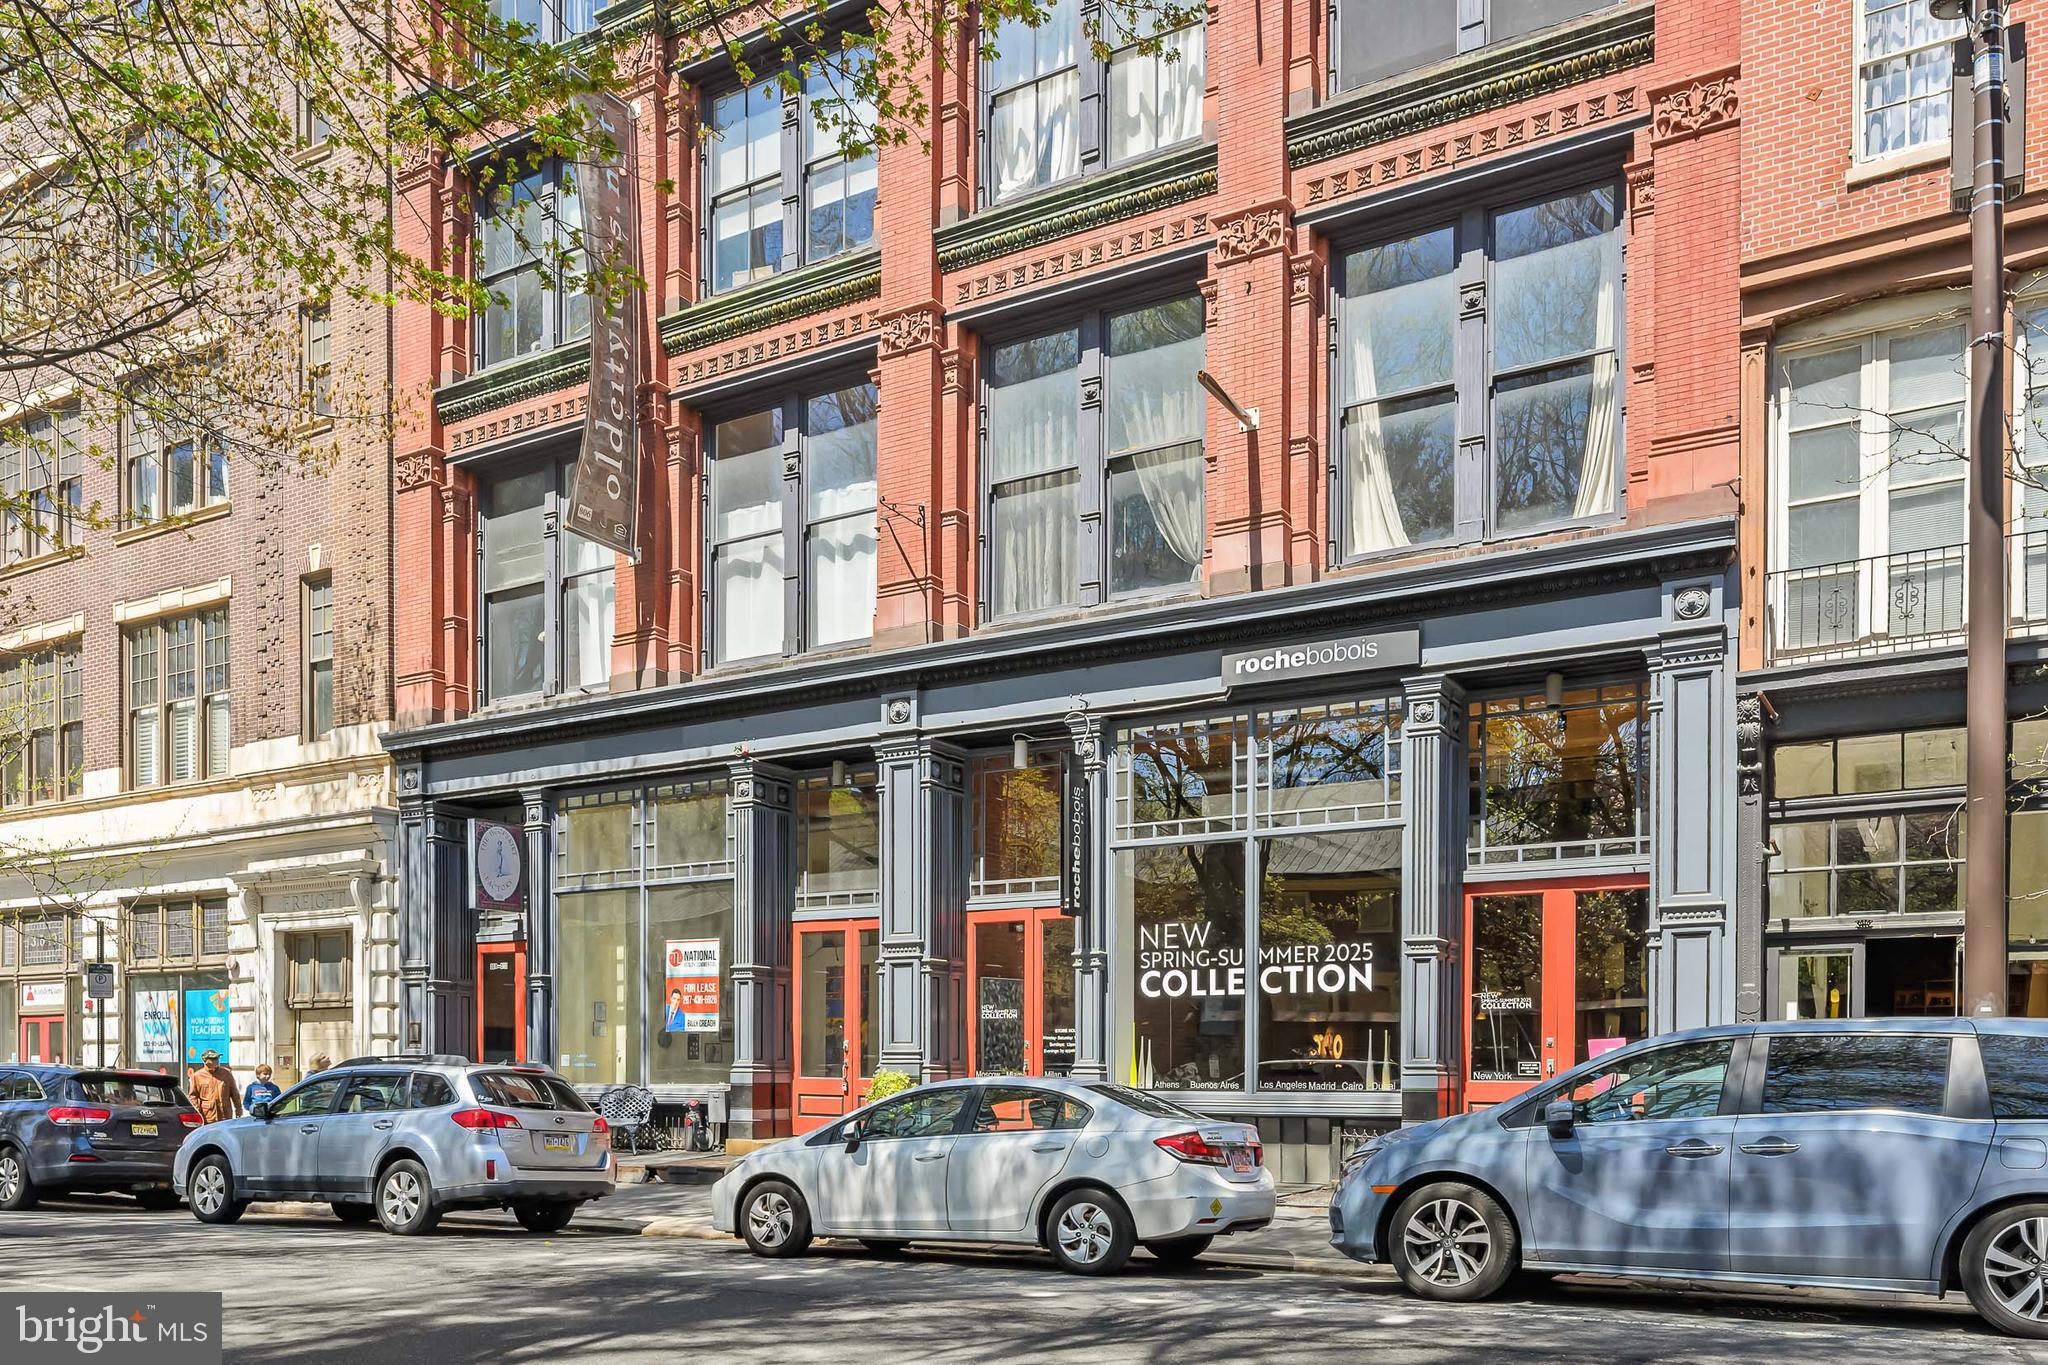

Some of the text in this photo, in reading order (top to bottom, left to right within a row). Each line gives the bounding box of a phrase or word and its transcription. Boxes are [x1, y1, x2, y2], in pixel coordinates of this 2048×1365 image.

[579, 506, 591, 518] 806
[1235, 639, 1378, 674] rochebobois
[1072, 787, 1081, 908] rochebobois
[282, 890, 346, 912] FREIGHT
[1140, 921, 1212, 950] NEW
[684, 950, 717, 961] NATIONAL
[1140, 943, 1374, 969] SPRING-SUMMER 2025
[1140, 963, 1373, 998] COLLECTION
[683, 983, 717, 992] FOR LEASE
[1481, 1001, 1532, 1009] COLLECTION
[143, 1010, 170, 1020] ENROLL
[981, 1011, 1018, 1019] COLLECTION
[144, 1022, 170, 1036] NOW
[191, 1025, 225, 1035] TEACHERS
[1473, 1072, 1513, 1080] New York
[1154, 1080, 1180, 1089] Athens
[1190, 1081, 1240, 1089] Buenos Aires
[1259, 1080, 1307, 1090] Los Angeles
[1308, 1081, 1336, 1090] Madrid
[1341, 1081, 1364, 1090] Cairo
[1372, 1081, 1396, 1090] Duai
